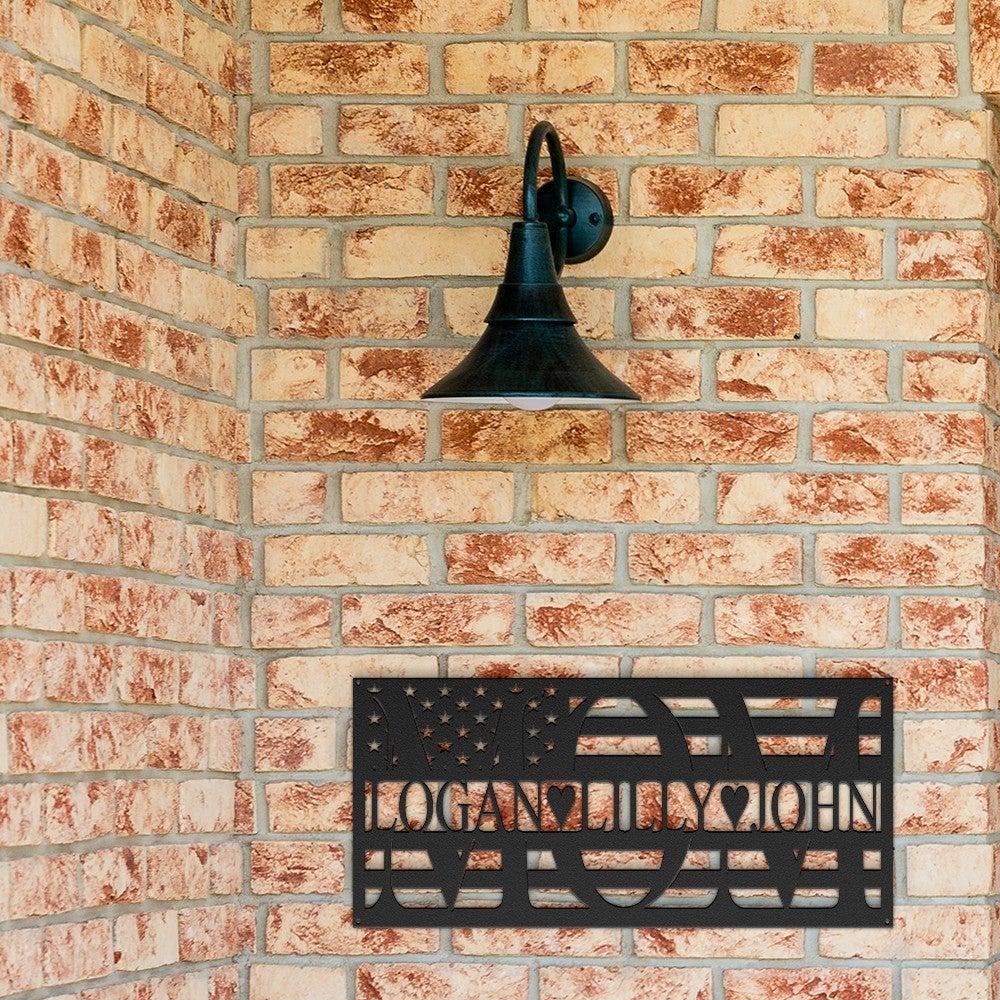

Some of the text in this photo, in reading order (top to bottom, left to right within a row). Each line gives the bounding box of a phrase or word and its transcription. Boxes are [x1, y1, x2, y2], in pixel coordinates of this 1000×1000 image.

[368, 780, 880, 833] LOGAN LILLY JOHN
